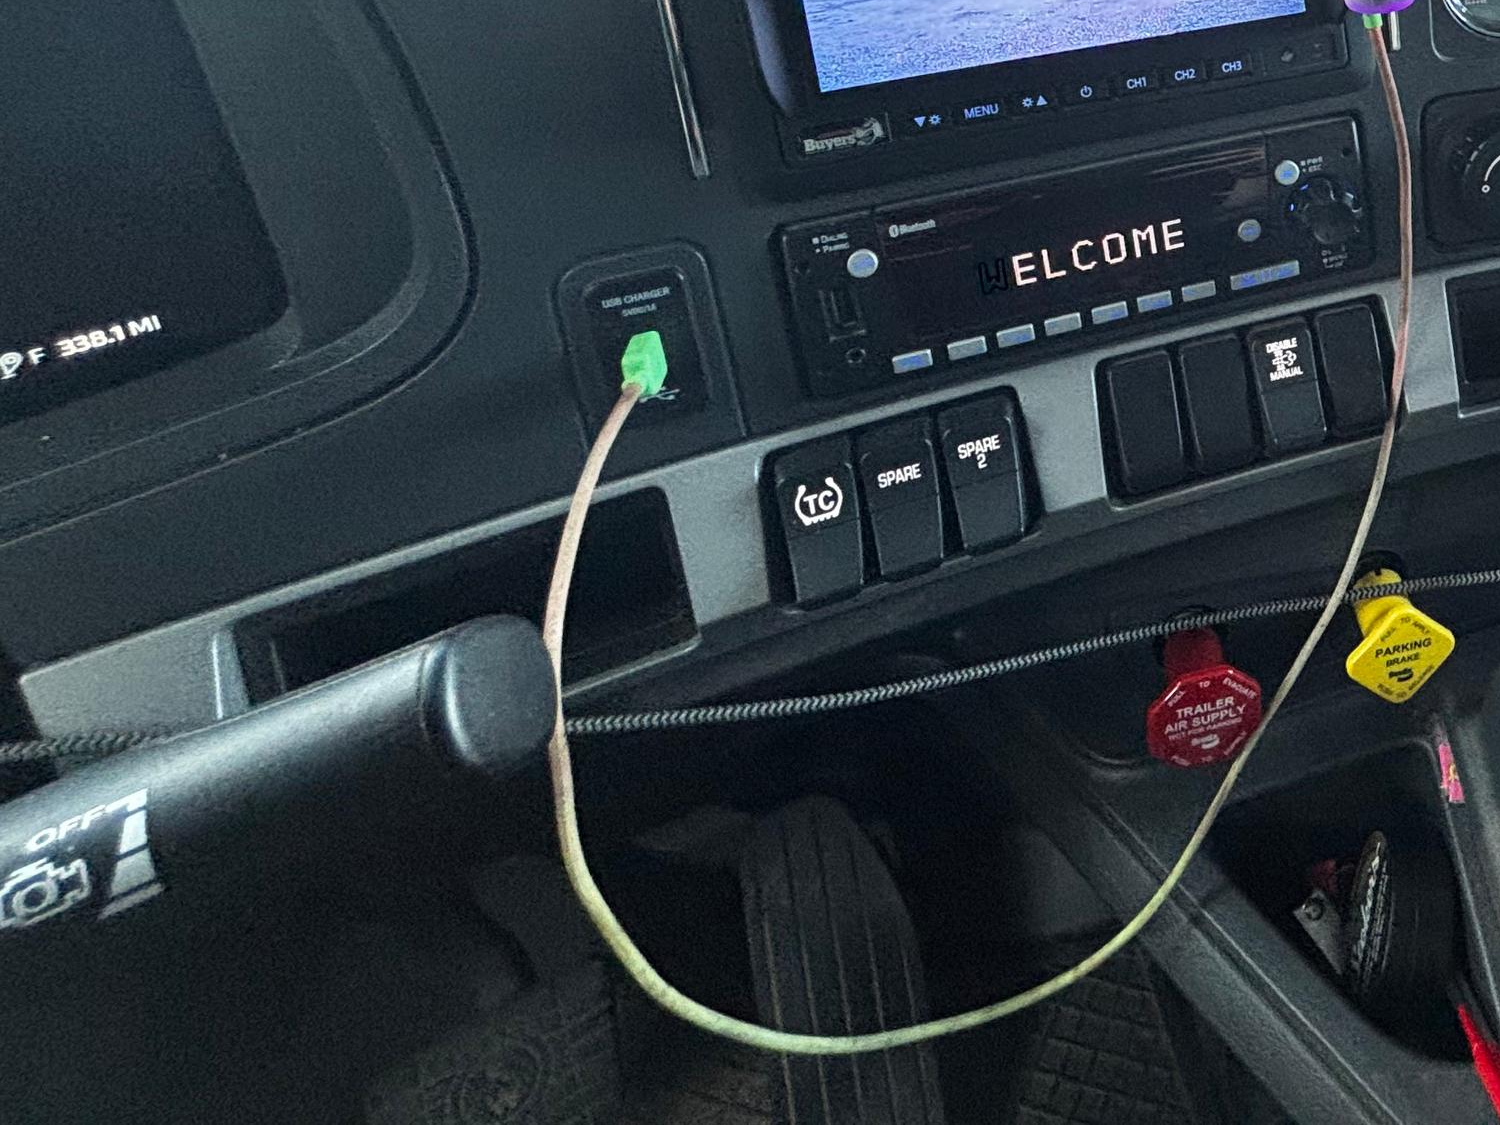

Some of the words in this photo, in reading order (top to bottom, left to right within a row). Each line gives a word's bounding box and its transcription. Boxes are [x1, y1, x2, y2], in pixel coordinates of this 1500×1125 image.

[1174, 68, 1197, 82] CH2
[1222, 60, 1243, 74] CH3
[1126, 76, 1148, 90] CH1
[964, 103, 1000, 120] MENU
[803, 134, 857, 152] Buyers
[601, 296, 622, 309] USB
[623, 286, 671, 304] CHARGER
[27, 346, 46, 365] F
[54, 325, 126, 358] 338.1
[127, 314, 162, 337] MI
[1265, 337, 1298, 354] DISABLE
[1269, 365, 1304, 382] MANUAL
[957, 434, 1001, 460] SPARE
[976, 453, 988, 469] 2
[877, 462, 922, 489] SPARE
[803, 489, 835, 515] TC
[1375, 637, 1432, 658] PARKING
[1385, 652, 1420, 668] BRAKE
[1176, 696, 1235, 719] TRAILER
[1164, 720, 1188, 735] AIR
[1192, 704, 1247, 727] SUPPLY
